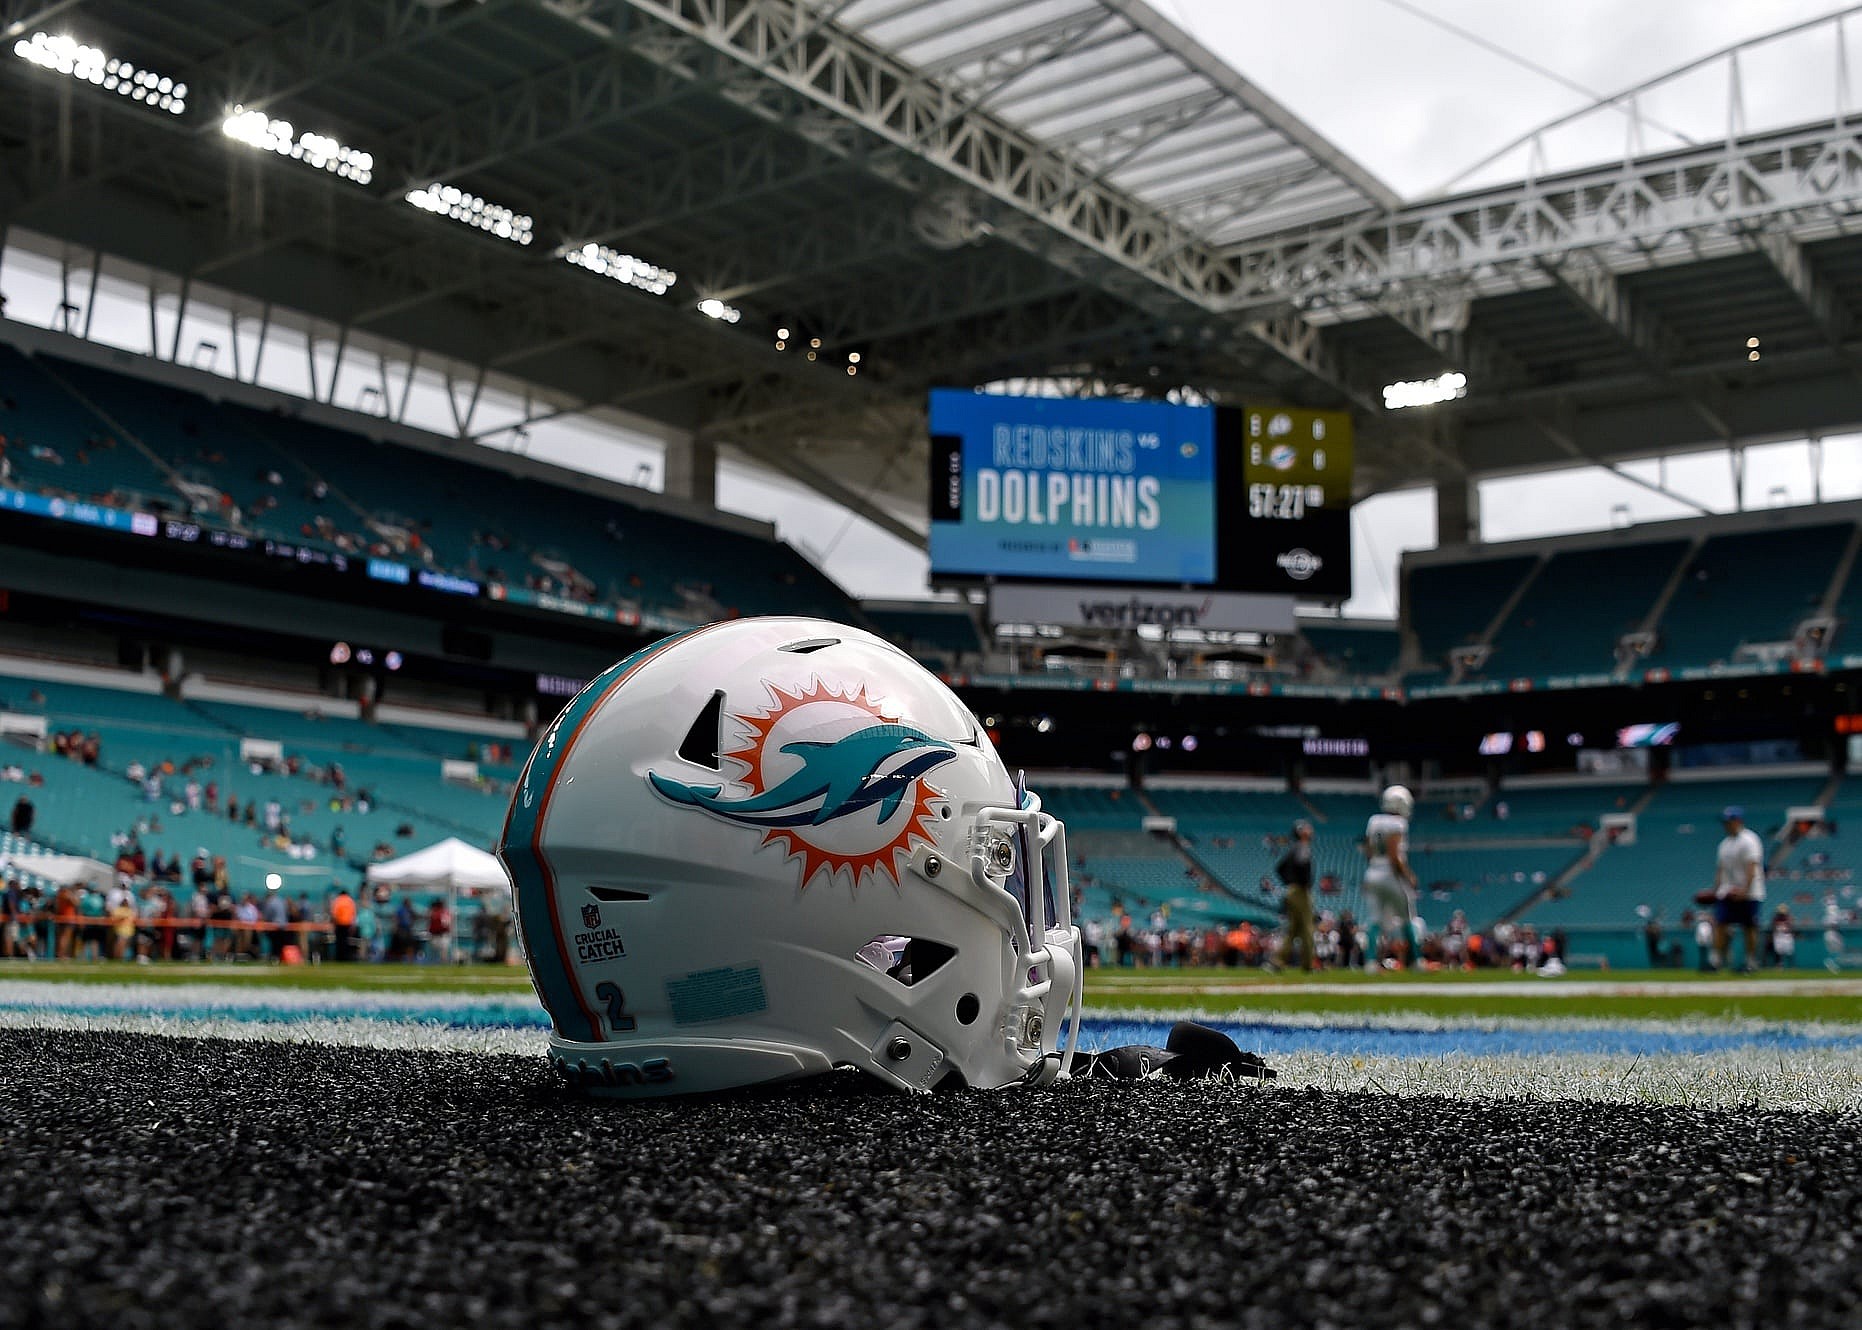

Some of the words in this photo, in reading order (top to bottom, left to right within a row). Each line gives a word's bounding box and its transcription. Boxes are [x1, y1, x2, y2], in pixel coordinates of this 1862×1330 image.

[993, 423, 1136, 473] REDSKINS
[977, 468, 1160, 530] DOLPHINS
[1079, 596, 1197, 626] verizon
[575, 928, 621, 945] CRUCIAL
[578, 940, 625, 960] CATCH
[595, 981, 636, 1031] 2
